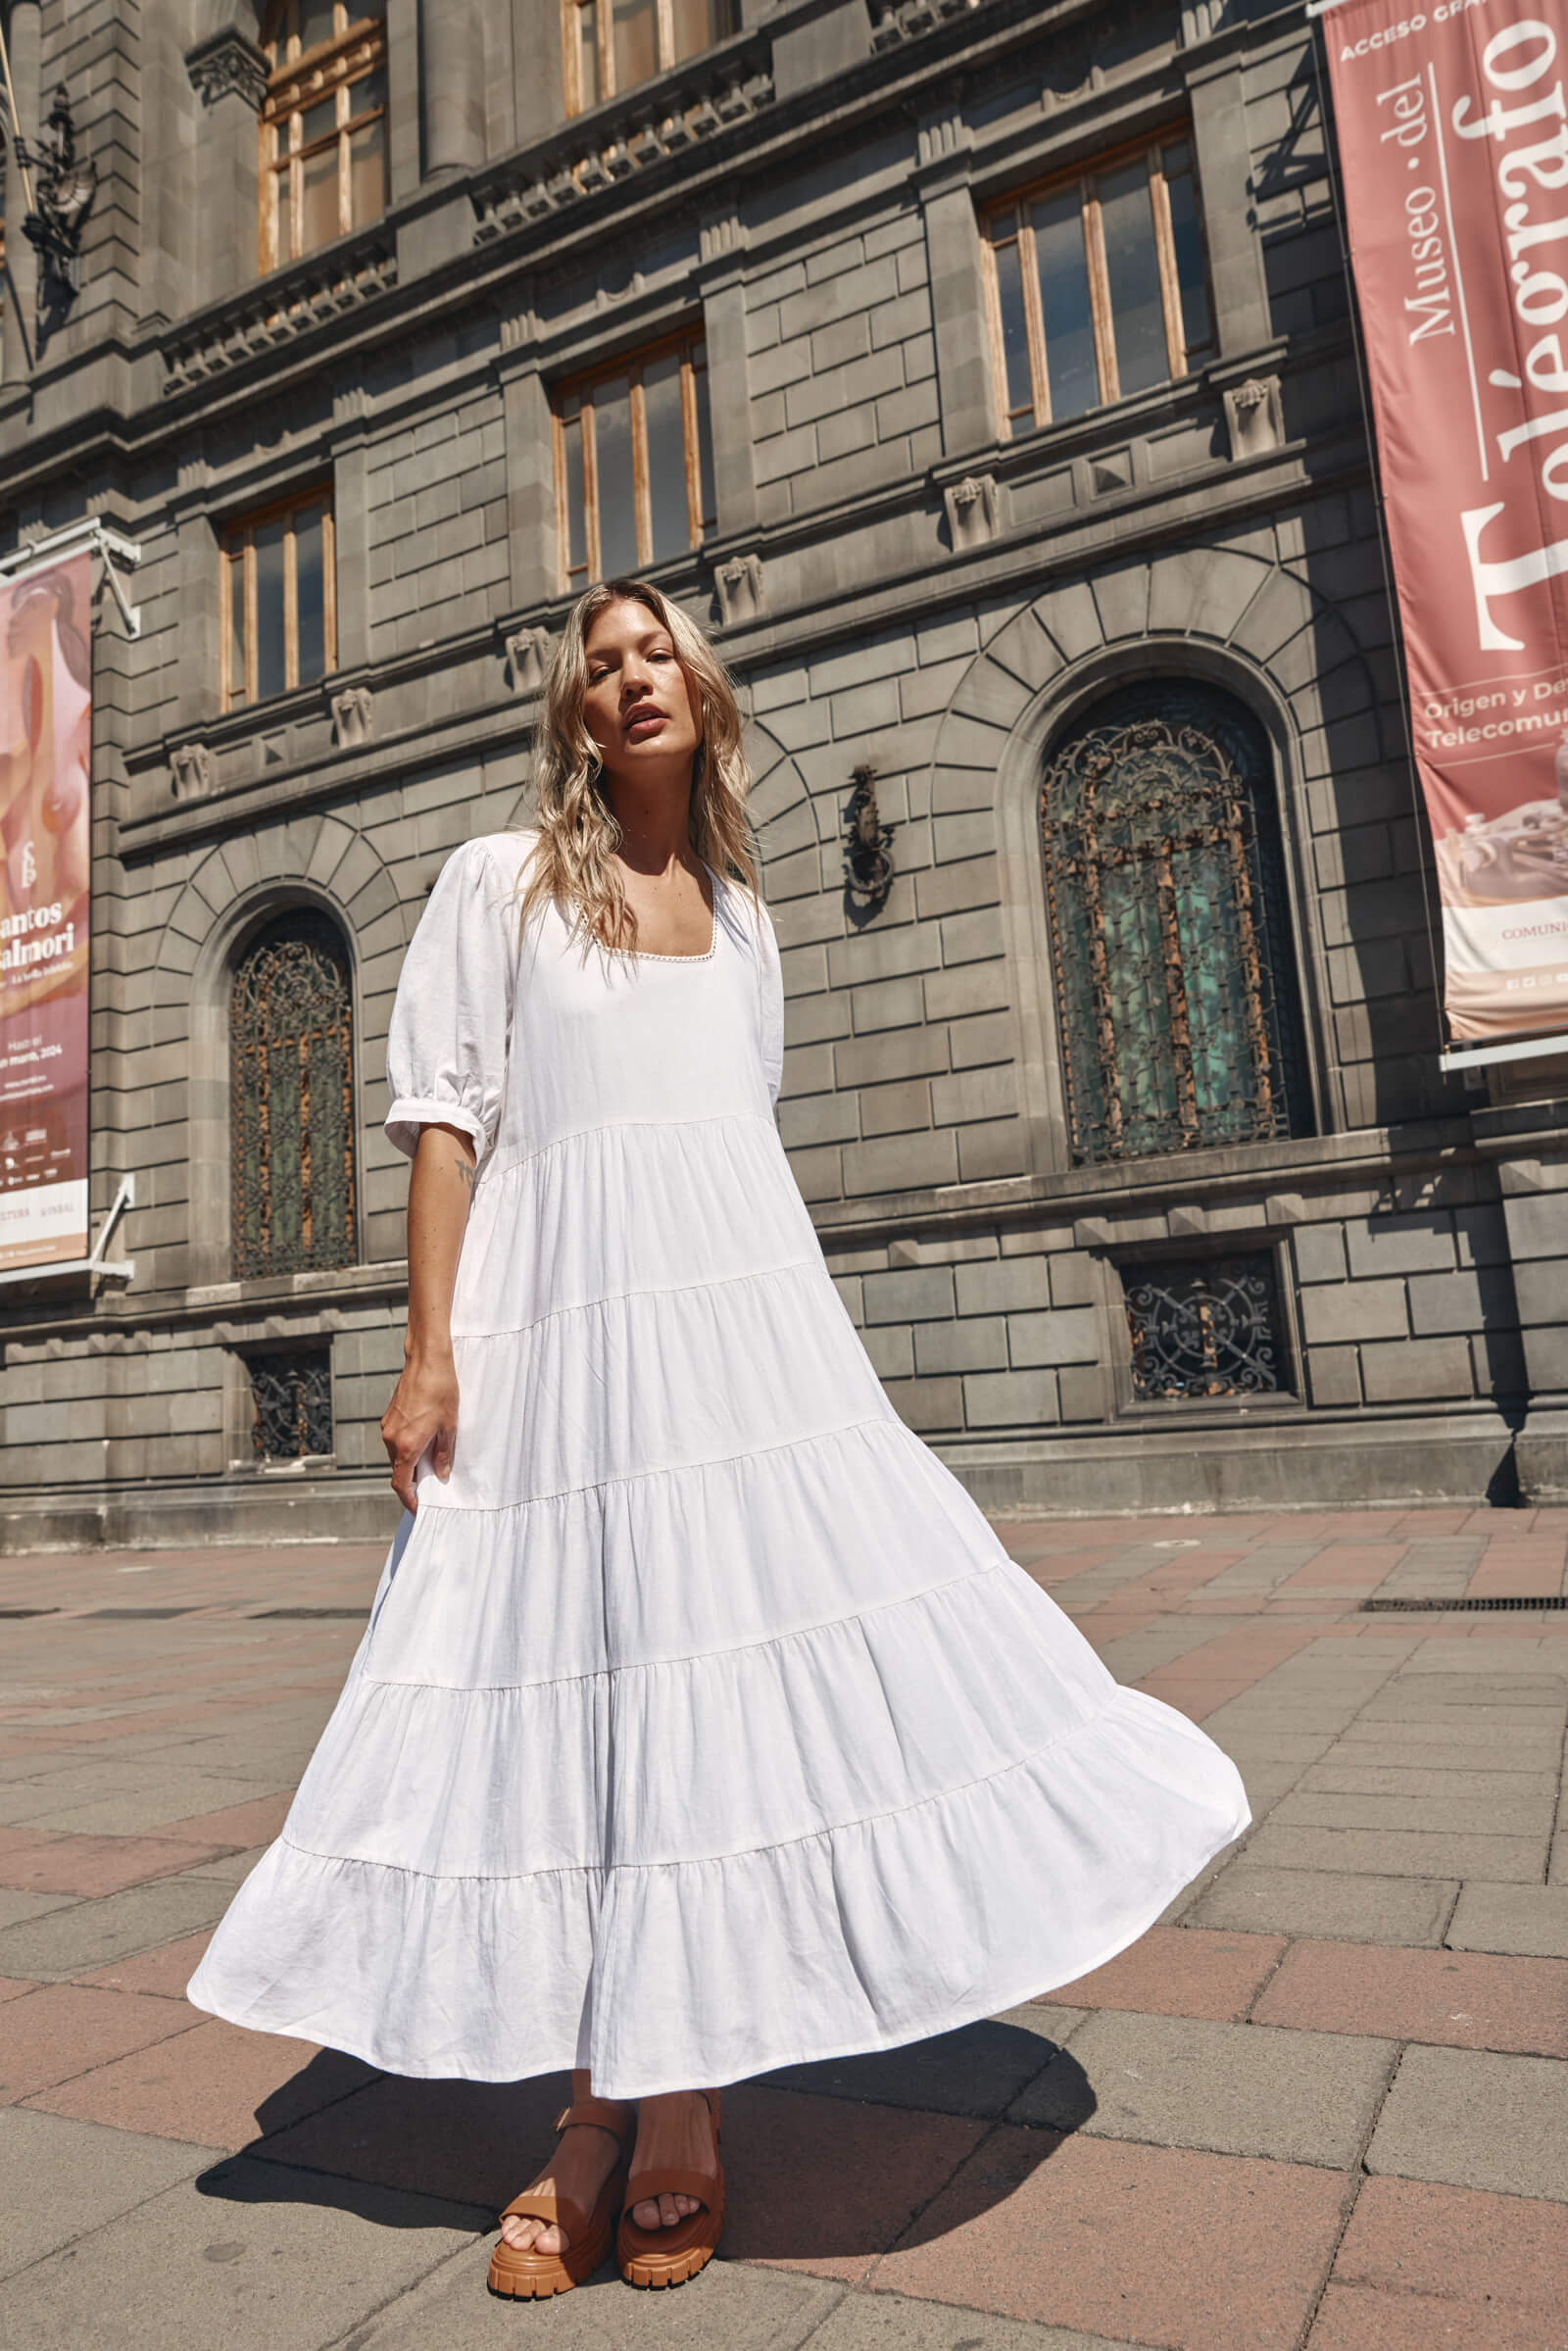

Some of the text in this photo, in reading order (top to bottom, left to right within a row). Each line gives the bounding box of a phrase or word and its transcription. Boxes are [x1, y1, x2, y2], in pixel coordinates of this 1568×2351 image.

[1341, 14, 1427, 62] ACCESO
[1376, 72, 1455, 346] Museo del
[1426, 678, 1568, 719] Origen y De
[0, 902, 62, 939] antos
[1501, 920, 1568, 940] COMUNI
[0, 922, 74, 971] almori
